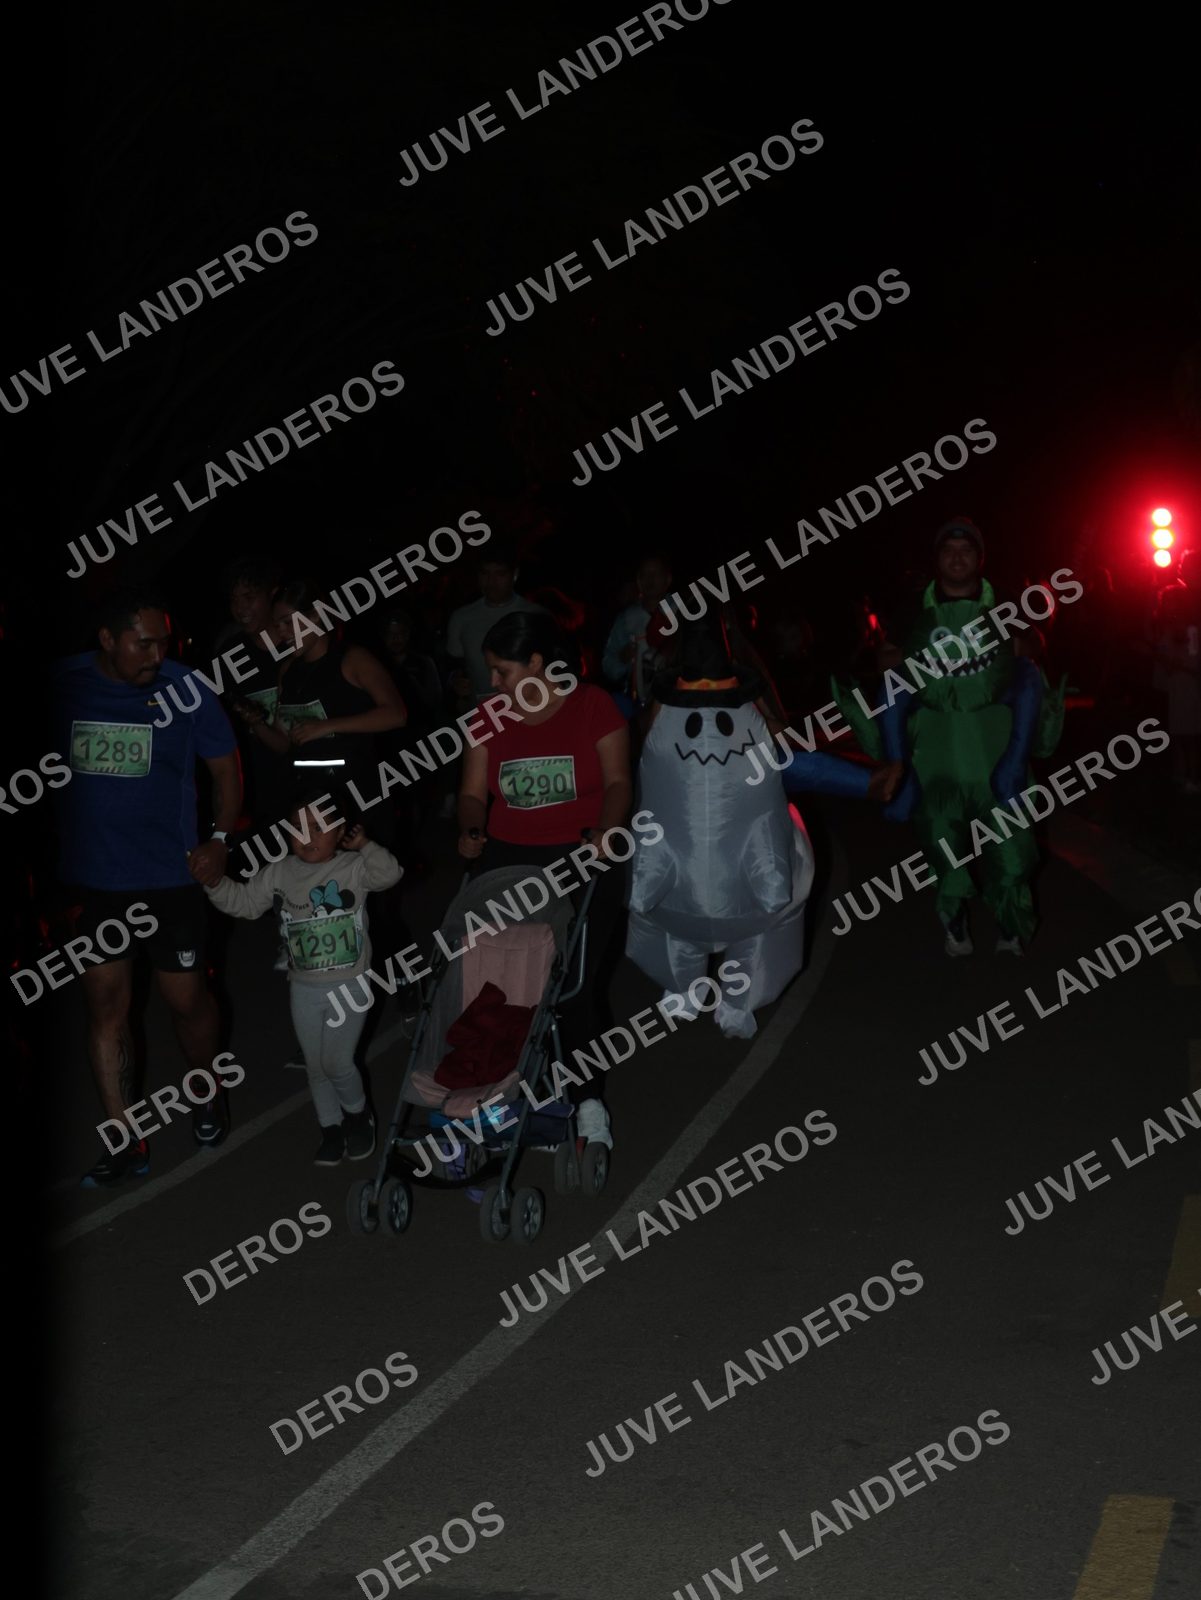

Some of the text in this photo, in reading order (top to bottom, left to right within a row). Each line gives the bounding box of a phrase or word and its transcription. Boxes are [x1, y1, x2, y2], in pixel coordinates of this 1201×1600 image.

[80, 739, 143, 763] 1289
[508, 773, 567, 797] 1290
[296, 929, 350, 958] 1291
